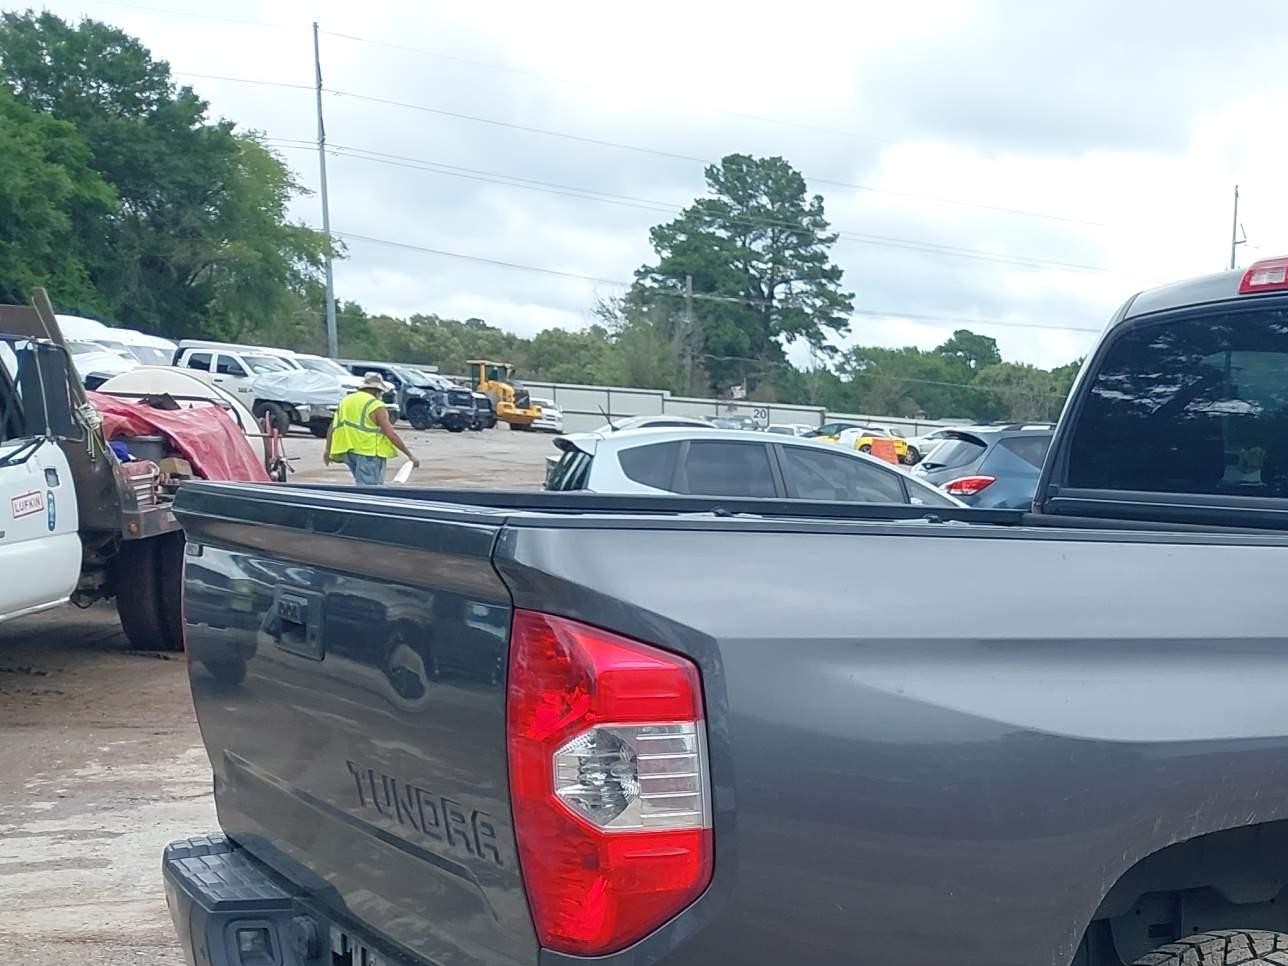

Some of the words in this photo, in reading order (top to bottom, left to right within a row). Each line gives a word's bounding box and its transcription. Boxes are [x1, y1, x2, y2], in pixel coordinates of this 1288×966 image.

[753, 408, 767, 420] 20
[14, 495, 41, 513] LUFKIN
[345, 759, 504, 867] TUNDRA
